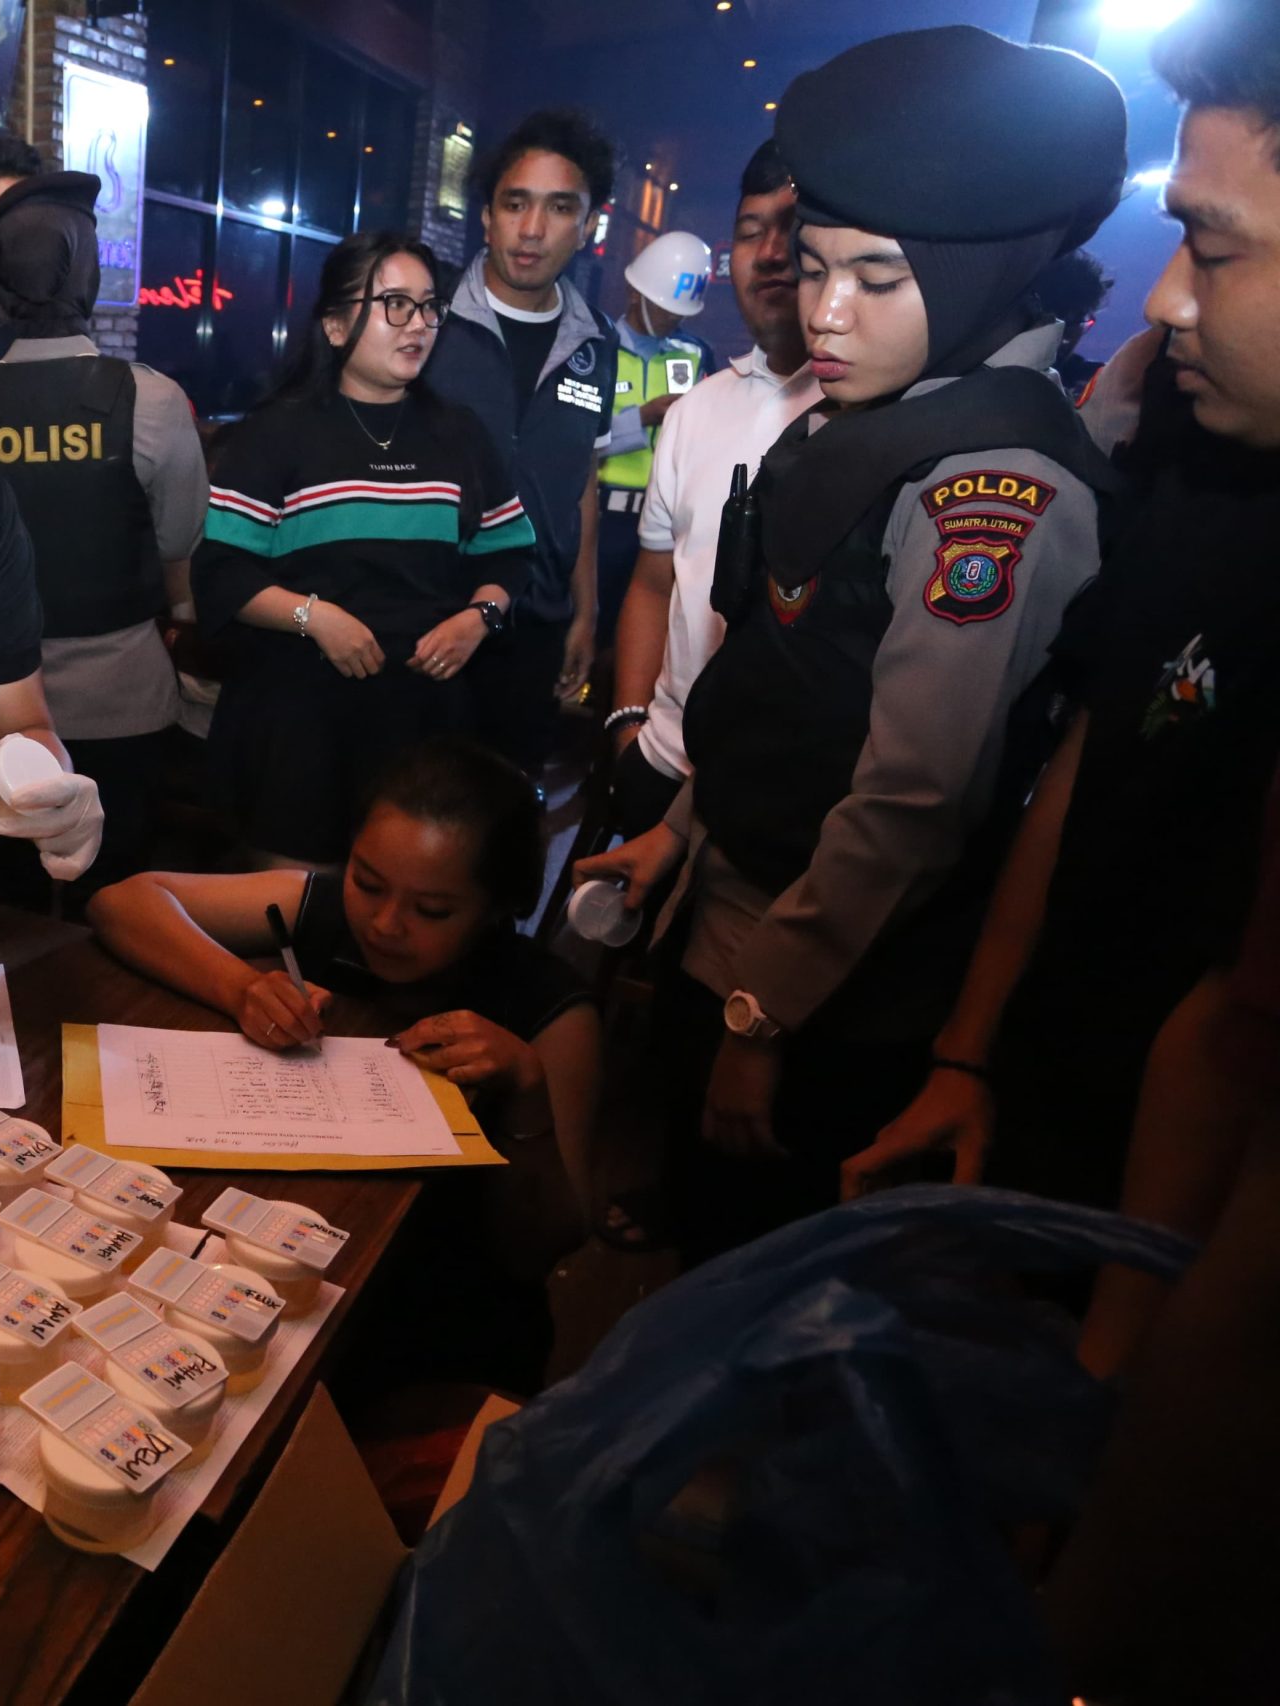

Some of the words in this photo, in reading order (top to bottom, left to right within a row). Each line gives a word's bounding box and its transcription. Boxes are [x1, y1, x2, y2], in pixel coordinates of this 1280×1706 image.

[368, 463, 394, 472] TURN
[394, 463, 418, 472] BACK
[933, 475, 1040, 507] POLDA
[944, 517, 988, 531] SUMATRA
[990, 519, 1023, 534] UTARA
